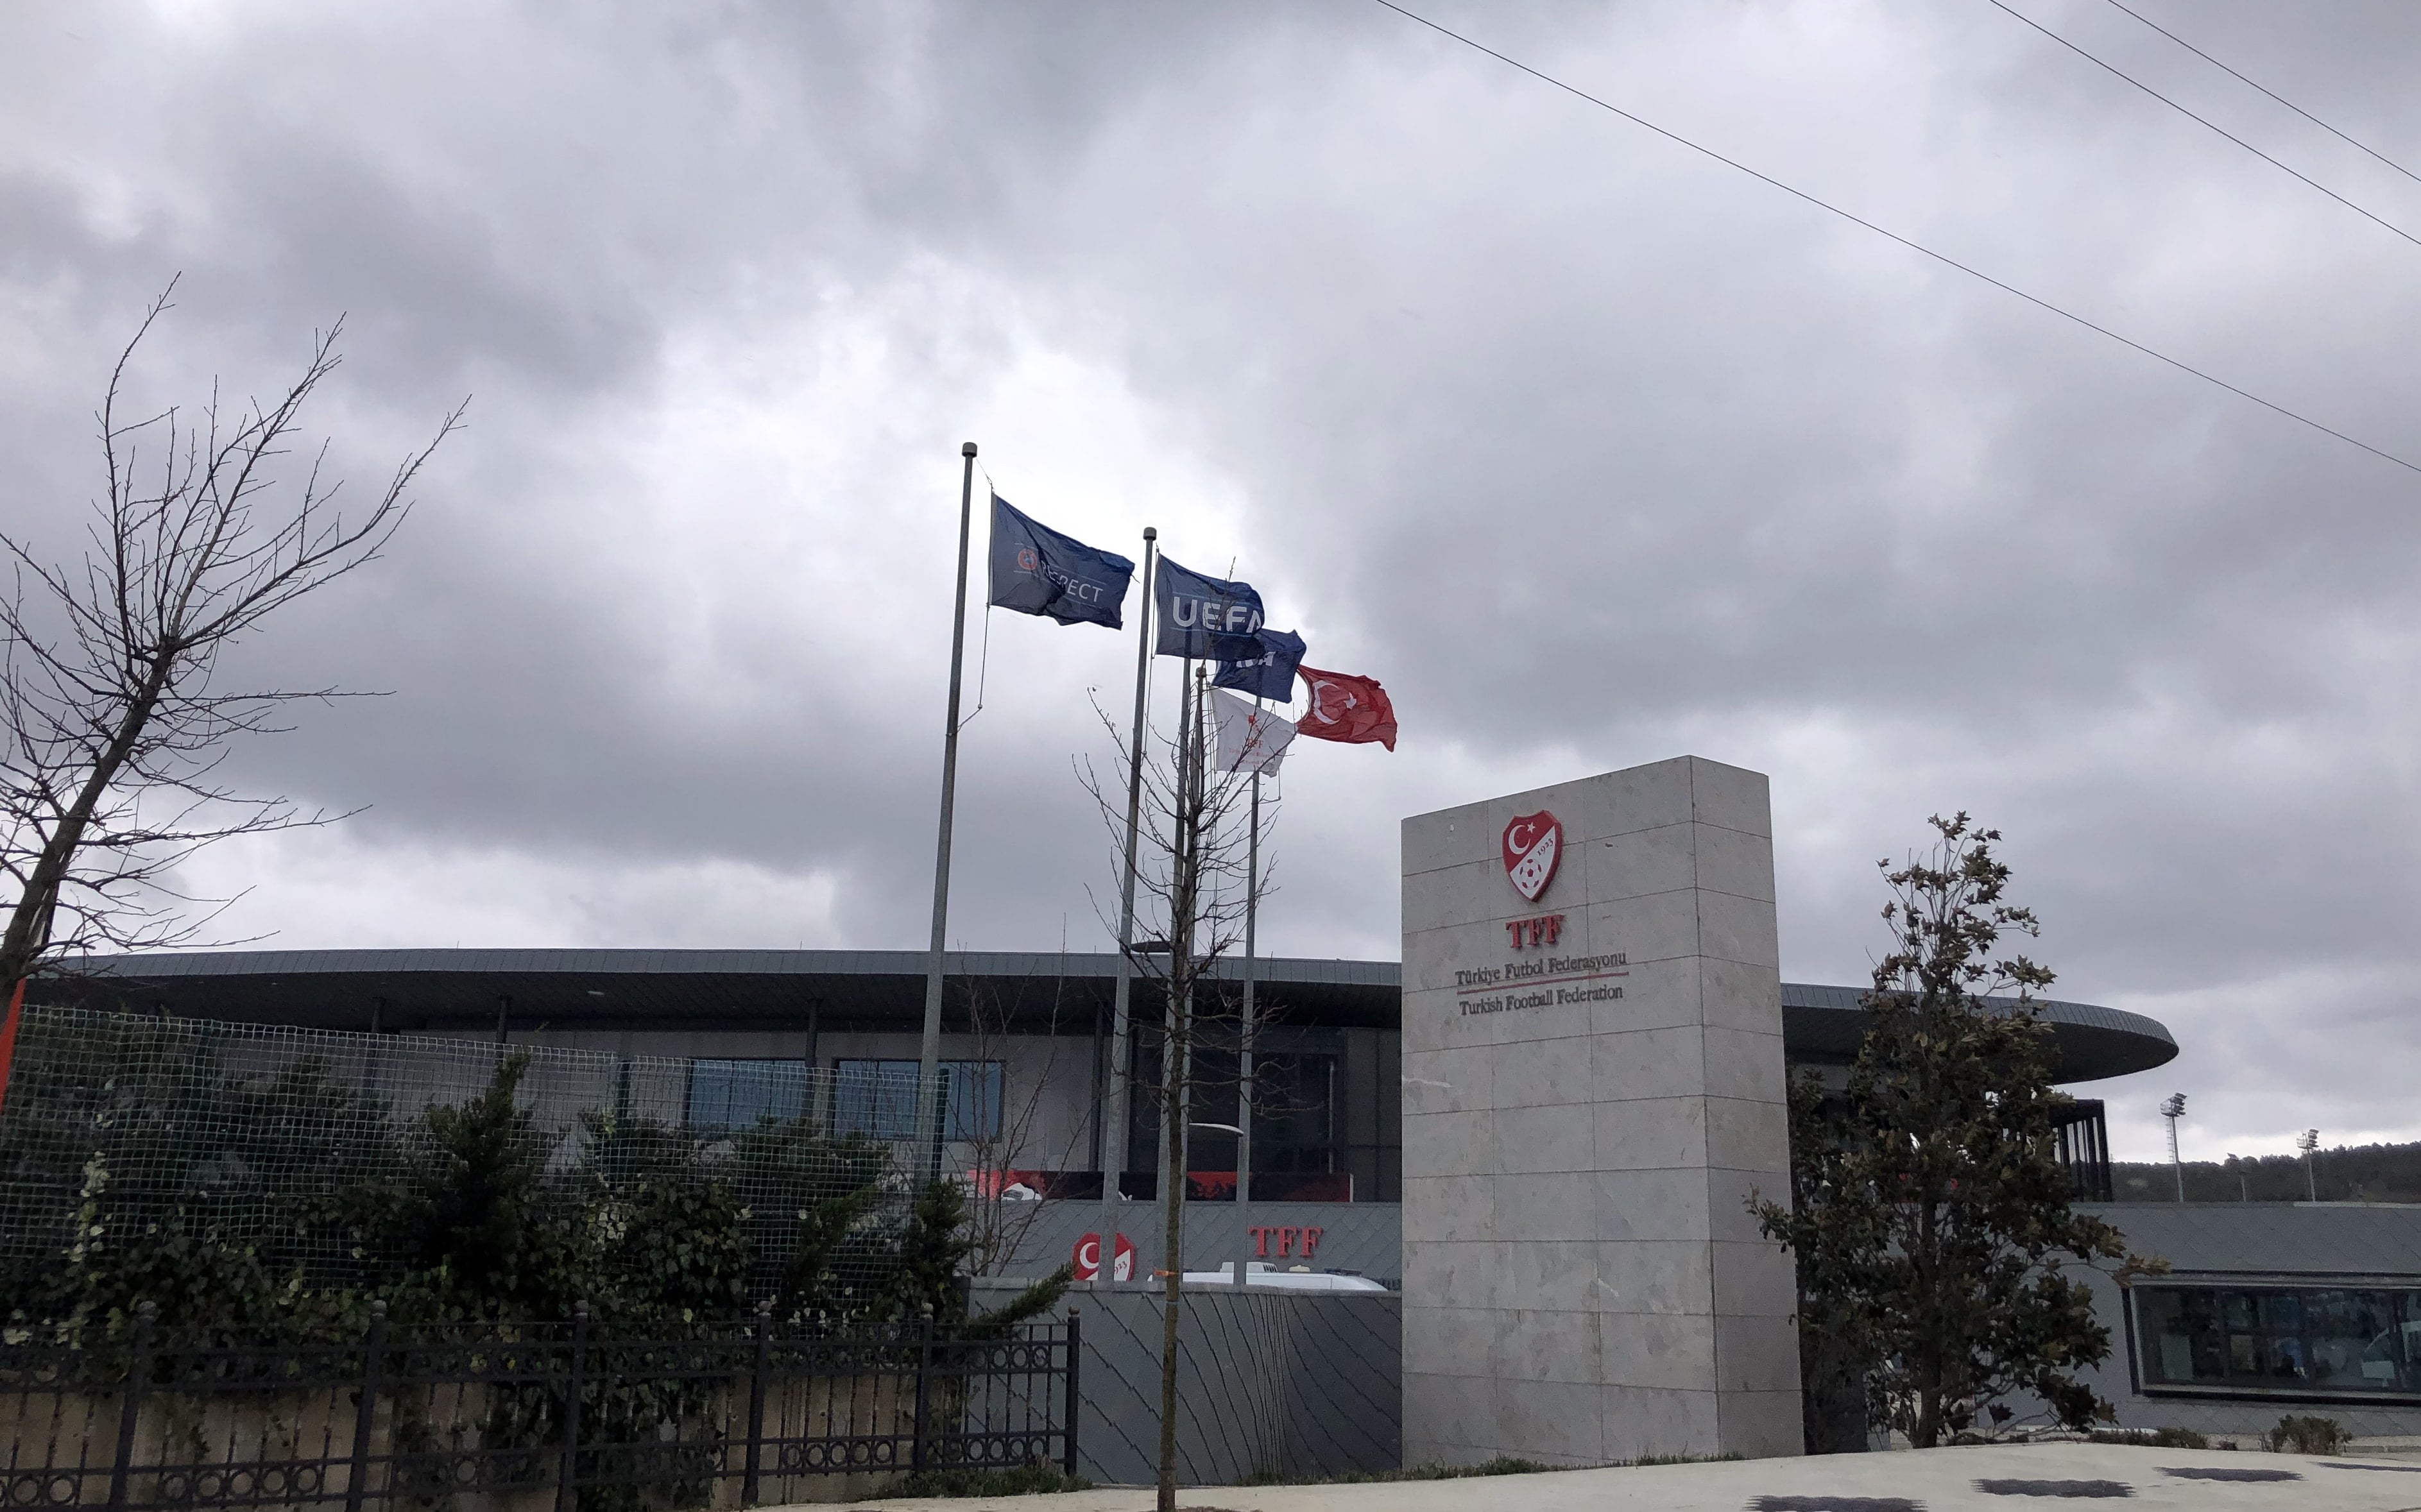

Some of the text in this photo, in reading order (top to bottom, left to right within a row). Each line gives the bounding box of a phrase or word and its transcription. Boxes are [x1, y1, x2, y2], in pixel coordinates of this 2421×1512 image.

[1172, 596, 1262, 633] UEFA
[1536, 838, 1553, 856] 1923
[1505, 914, 1565, 949] TFF
[1455, 953, 1628, 986] Türkiye Futbol Federasyonu
[1459, 984, 1623, 1016] Turkish Football Federation
[1247, 1225, 1323, 1258] TFF
